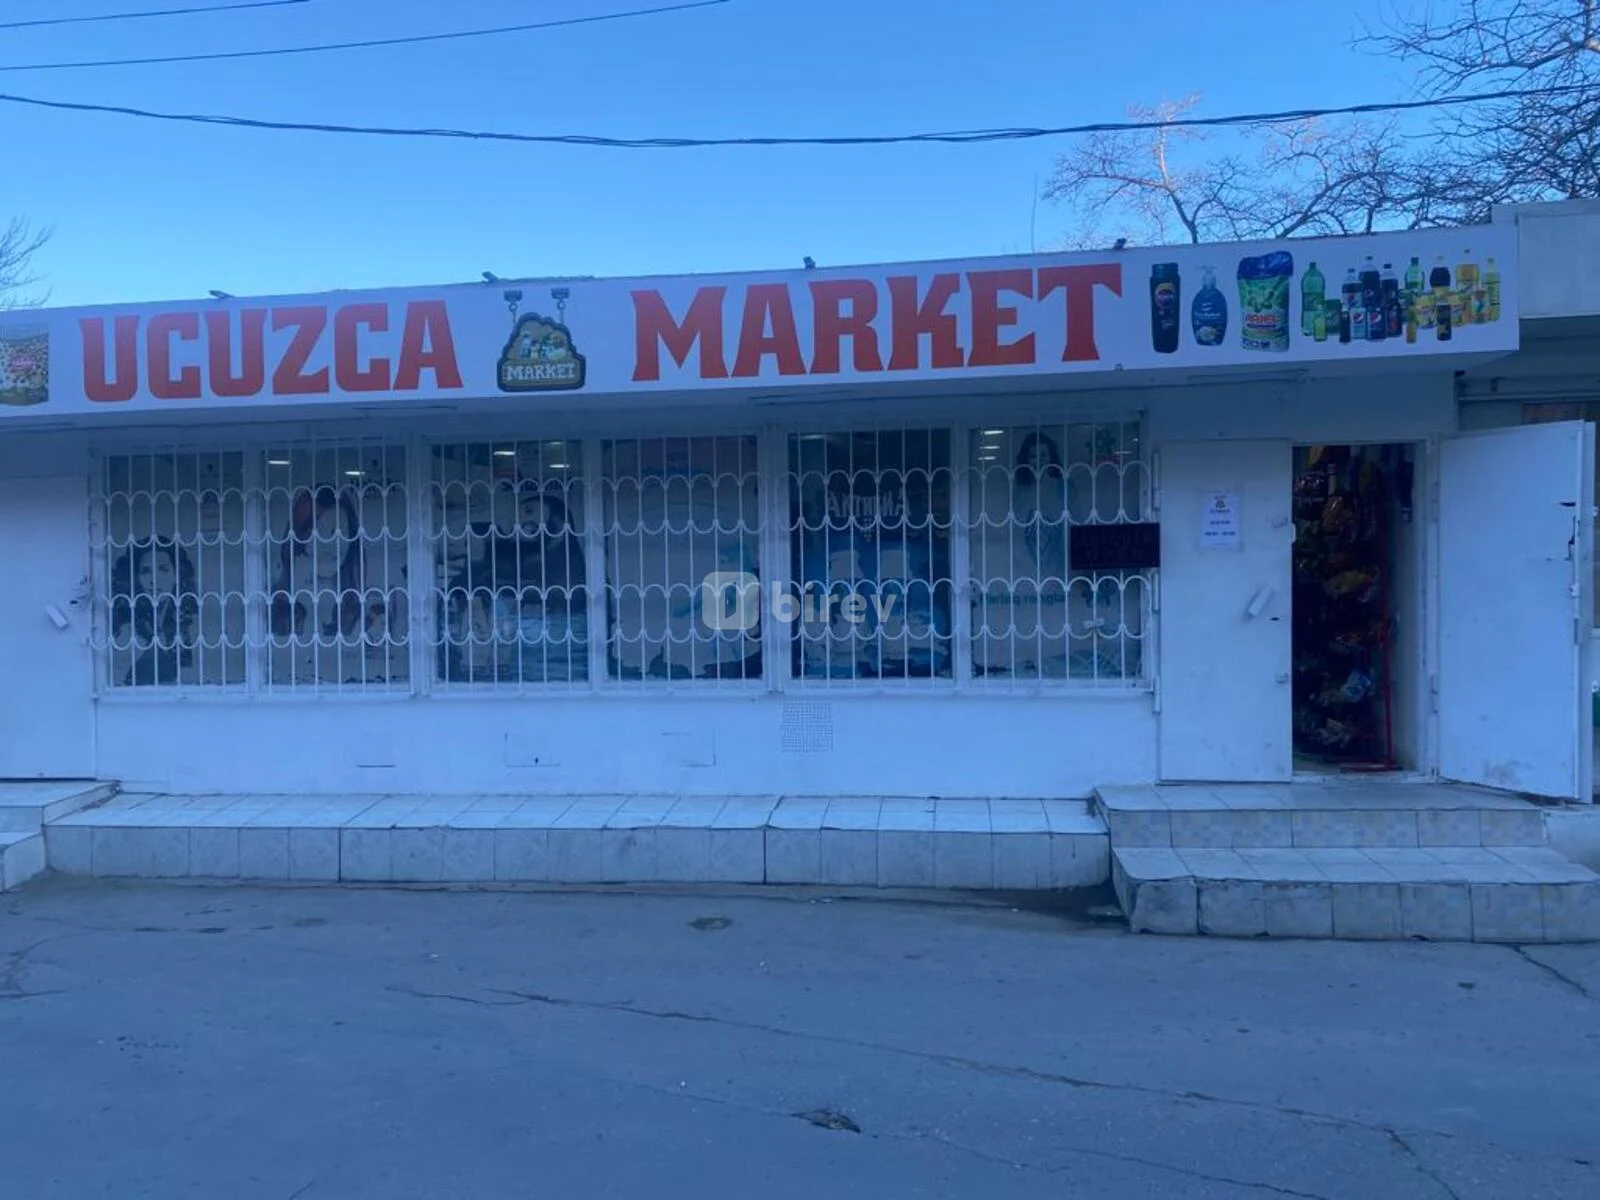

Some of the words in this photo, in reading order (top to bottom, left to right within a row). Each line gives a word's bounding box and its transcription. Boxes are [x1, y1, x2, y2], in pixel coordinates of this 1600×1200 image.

[80, 300, 463, 402] UCUZCA
[631, 264, 1121, 380] MARKET
[506, 363, 576, 381] MARKET
